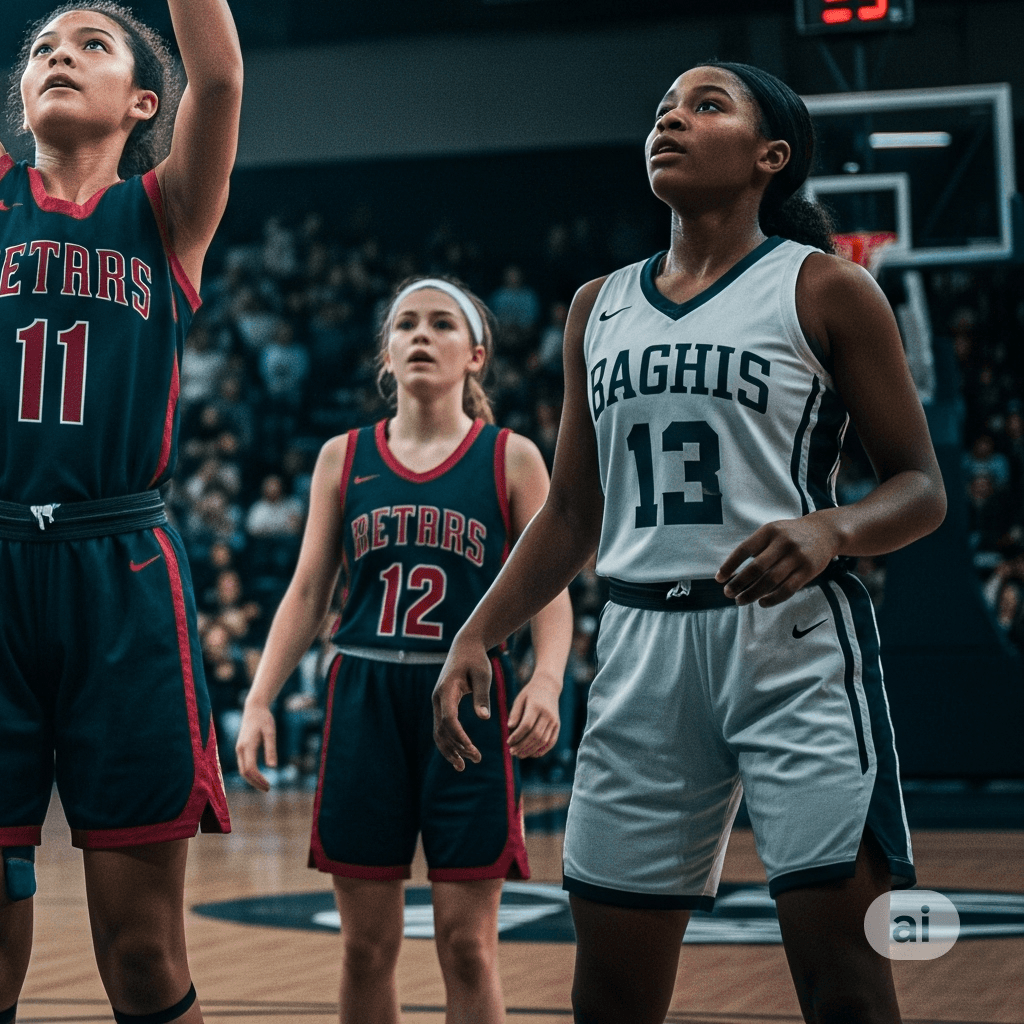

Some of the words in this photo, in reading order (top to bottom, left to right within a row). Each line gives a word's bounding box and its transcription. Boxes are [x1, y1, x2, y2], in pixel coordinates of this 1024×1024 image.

[16, 318, 89, 425] 11
[590, 343, 771, 414] BAGHIS
[626, 421, 723, 528] 13
[377, 562, 447, 640] 12
